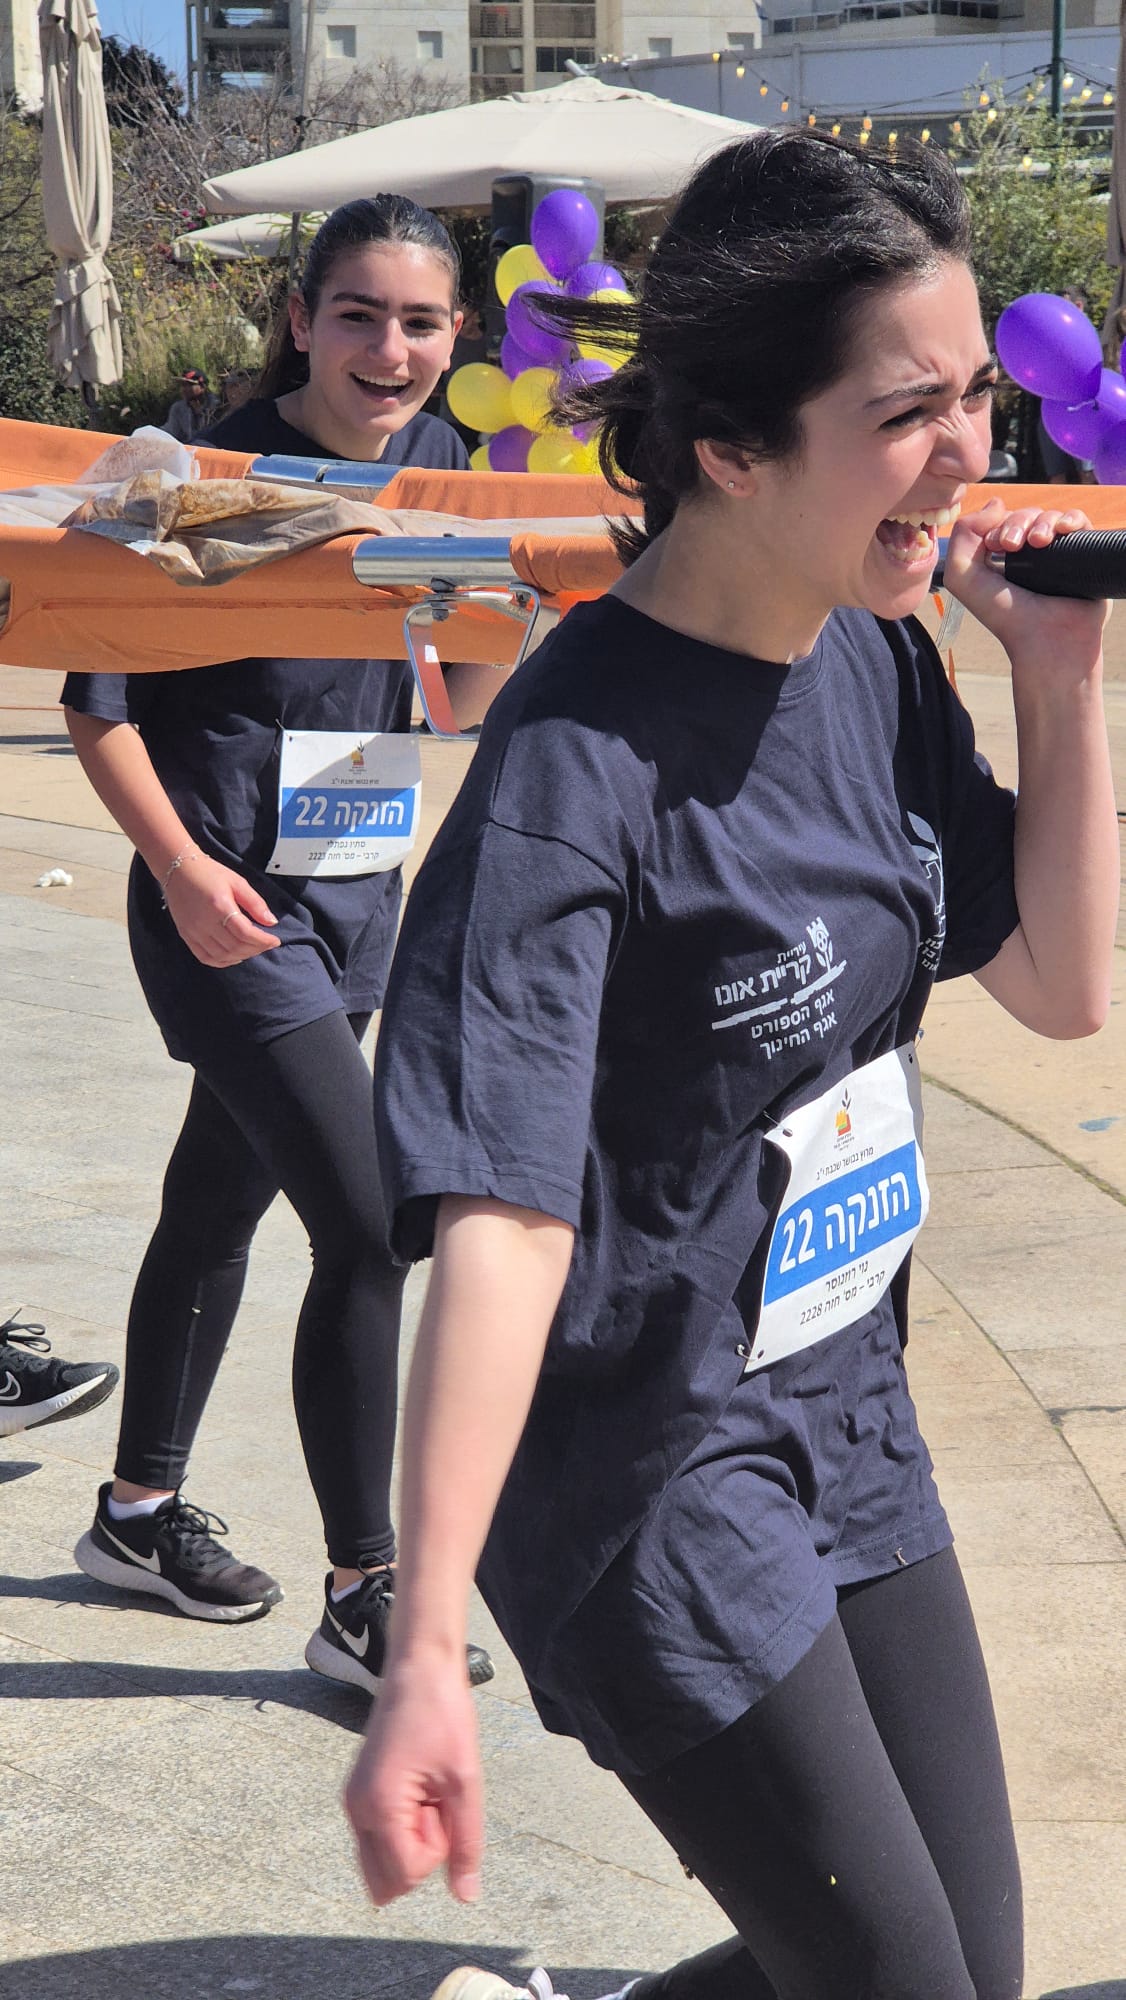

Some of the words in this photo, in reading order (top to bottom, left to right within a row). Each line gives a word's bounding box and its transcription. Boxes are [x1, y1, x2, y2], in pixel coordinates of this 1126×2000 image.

[295, 795, 328, 826] 22
[333, 800, 405, 833] הזנקה
[777, 941, 807, 963] עיריית
[760, 954, 812, 993] קריית
[714, 977, 757, 1006] אונו
[814, 988, 835, 1016] אגף
[751, 1005, 811, 1039] הספורט
[813, 1012, 838, 1039] אגף
[760, 1028, 811, 1060] החינוך
[824, 1171, 911, 1254] הזנקה
[779, 1207, 816, 1275] 22
[799, 1301, 823, 1326] 2228
